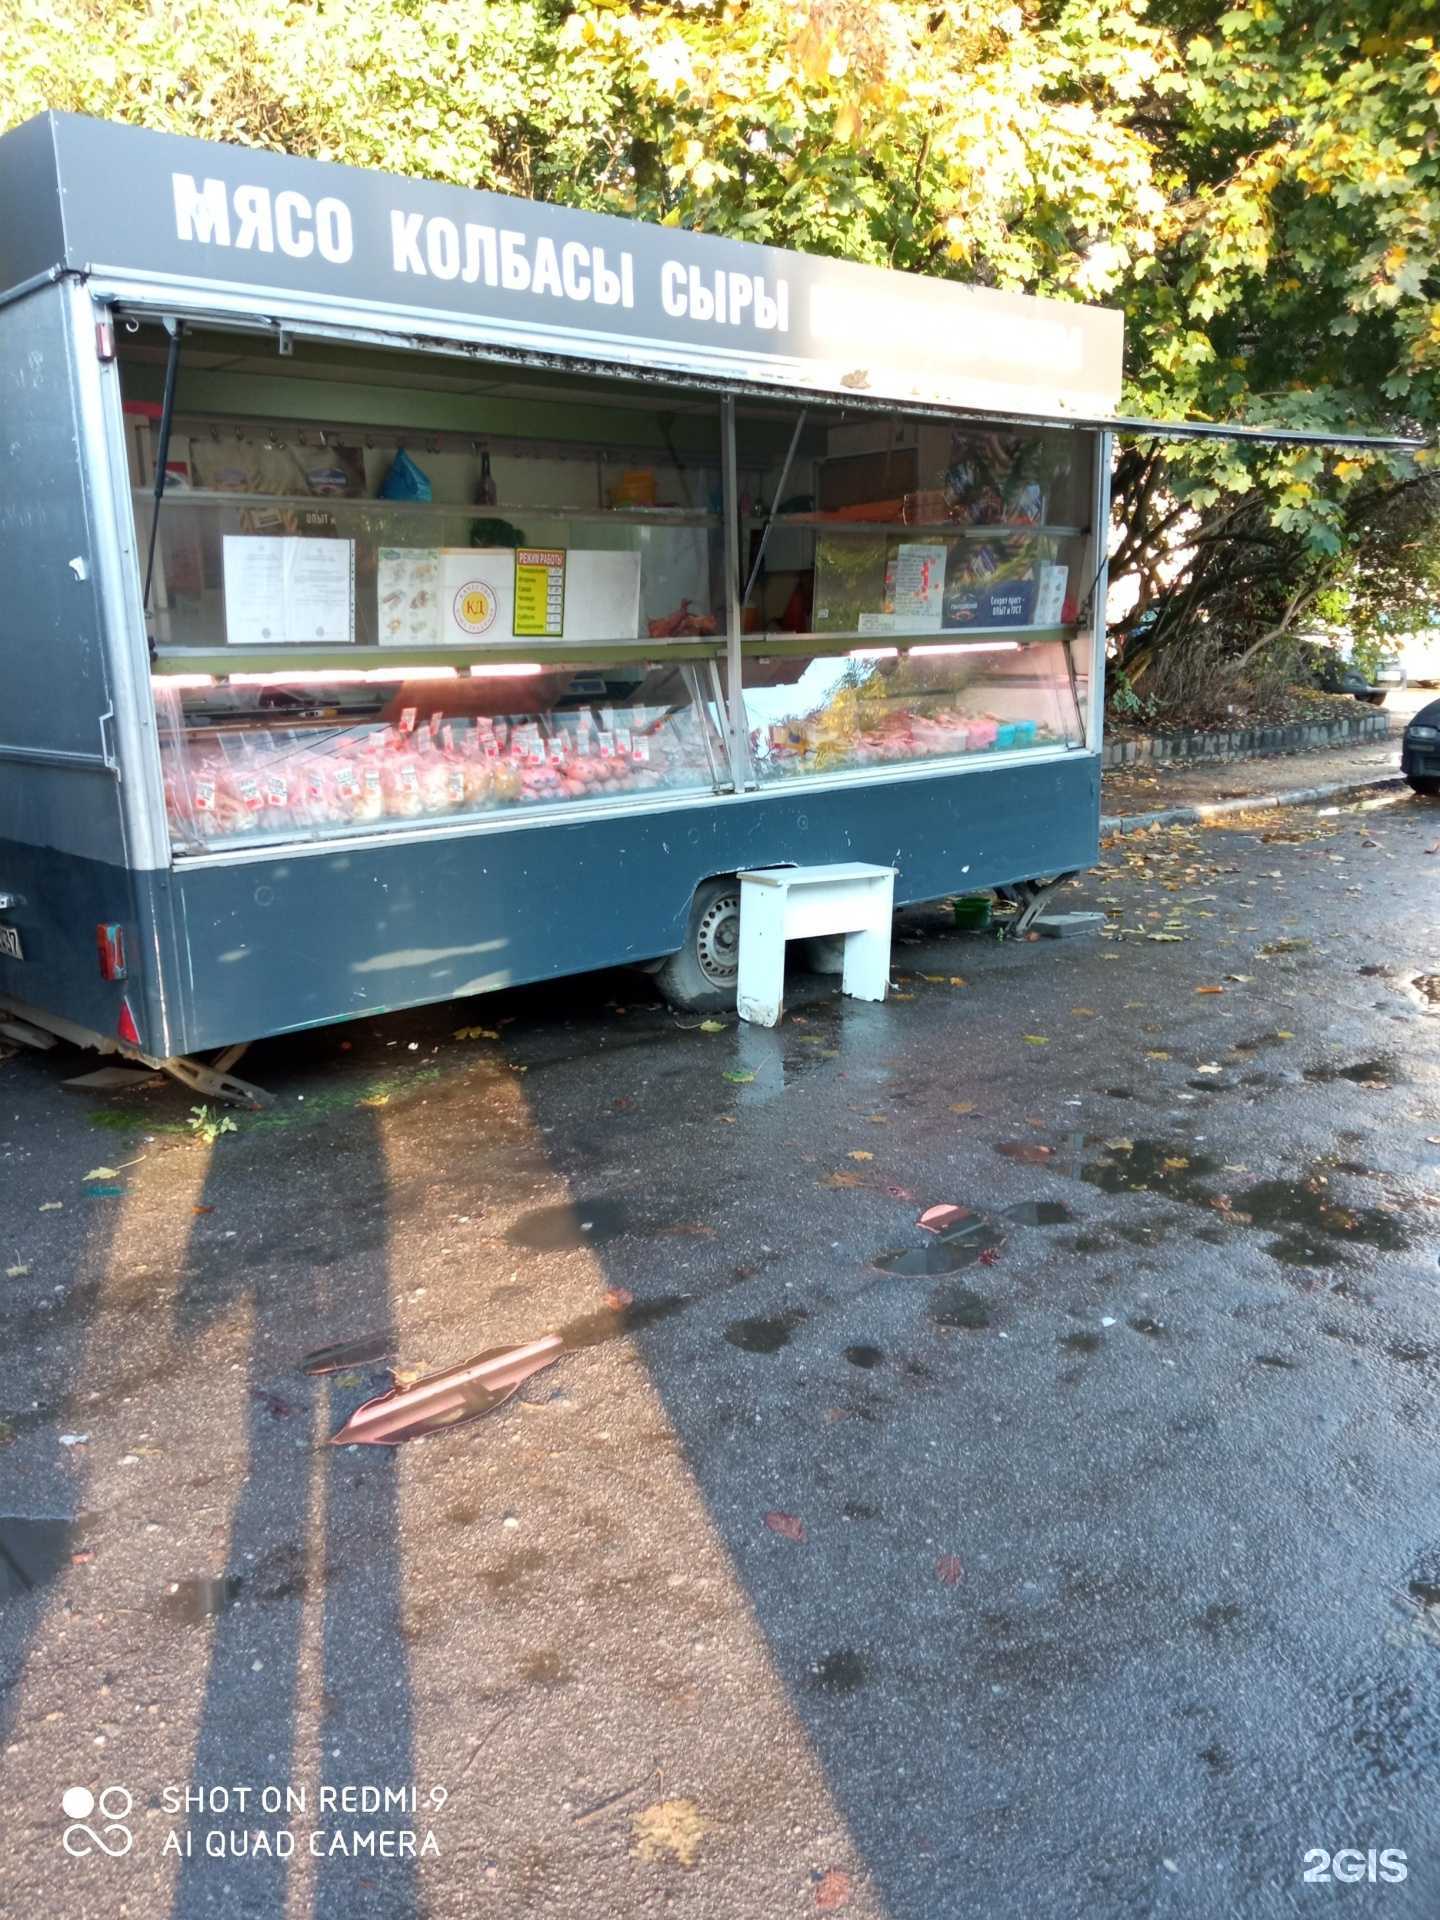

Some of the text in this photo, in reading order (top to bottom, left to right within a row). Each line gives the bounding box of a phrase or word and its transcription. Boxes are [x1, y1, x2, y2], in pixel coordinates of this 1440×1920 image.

[172, 172, 354, 264] МЯСО
[390, 209, 635, 308] КОЛБАСЫ
[661, 260, 789, 332] СЫРЫ
[466, 599, 485, 616] КД
